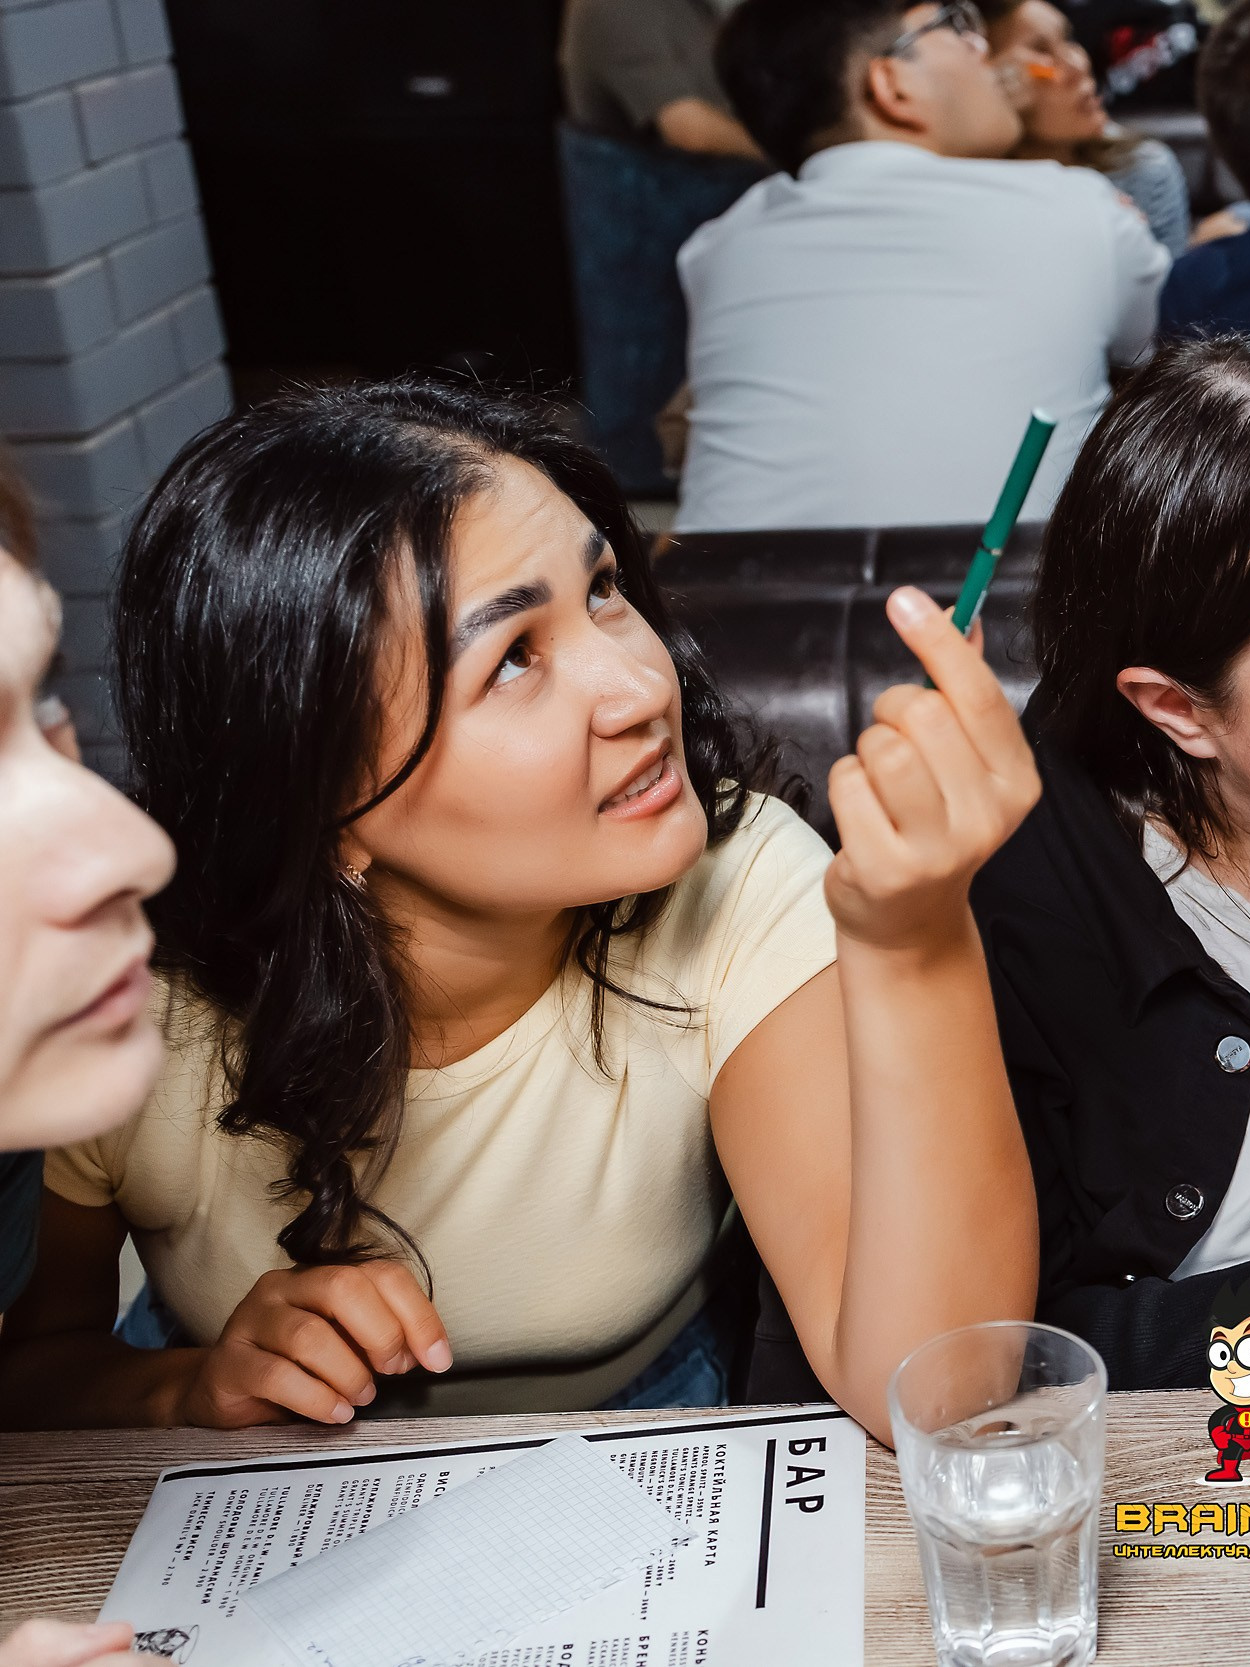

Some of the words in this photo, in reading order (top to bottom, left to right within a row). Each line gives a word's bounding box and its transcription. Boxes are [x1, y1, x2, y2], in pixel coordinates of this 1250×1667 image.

[638, 1451, 647, 1482] VERMOUTH
[649, 1451, 658, 1476] NEGRONI
[658, 1449, 668, 1483] HENDRICK'S
[669, 1448, 679, 1482] TULLAMORE
[680, 1448, 689, 1471] GRANT'S
[691, 1447, 699, 1468] GRANTS
[702, 1446, 710, 1467] APEROL
[678, 1473, 686, 1491] TONIC
[688, 1471, 696, 1494] ORANGE
[699, 1469, 707, 1489] SPRITZ
[709, 1444, 727, 1524] КОКТЕЙЛЬНАЯ
[785, 1437, 827, 1513] БАР
[192, 1492, 203, 1507] JACK
[222, 1490, 237, 1517] MONKEY
[299, 1484, 314, 1517] DUBLINER
[335, 1481, 349, 1508] GRANT'S
[345, 1480, 359, 1507] GRANT'S
[356, 1479, 369, 1506] GRANT'S
[359, 1478, 381, 1534] КУПАЖИРОВАН
[388, 1475, 405, 1518] GLENFIDDICH
[666, 1485, 674, 1503] D.E.W.
[194, 1491, 215, 1531] ТЕННЕССИ
[226, 1489, 249, 1539] СОЛОДОВЫЙ
[249, 1488, 268, 1527] TULLAMORE
[260, 1487, 279, 1526] TULLAMORE
[270, 1486, 290, 1530] TULLAMORE
[348, 1509, 361, 1530] TRIPLE
[685, 1497, 693, 1517] SPRITZ
[179, 1510, 197, 1540] DANIEL'S
[293, 1483, 324, 1558] КУПАЖИРОВАННЫЙ
[326, 1511, 340, 1535] WINTER
[336, 1510, 350, 1537] SUMMER
[183, 1534, 199, 1561] ВИСКИ
[208, 1520, 226, 1556] SHOULDER
[260, 1535, 274, 1559] D.E.W.
[704, 1530, 718, 1567] КАРТА
[201, 1542, 230, 1604] ШОТЛАНДСКИЙ
[231, 1555, 244, 1578] HONEY
[237, 1555, 255, 1586] ORIGINAL
[248, 1562, 264, 1589] FAMIL
